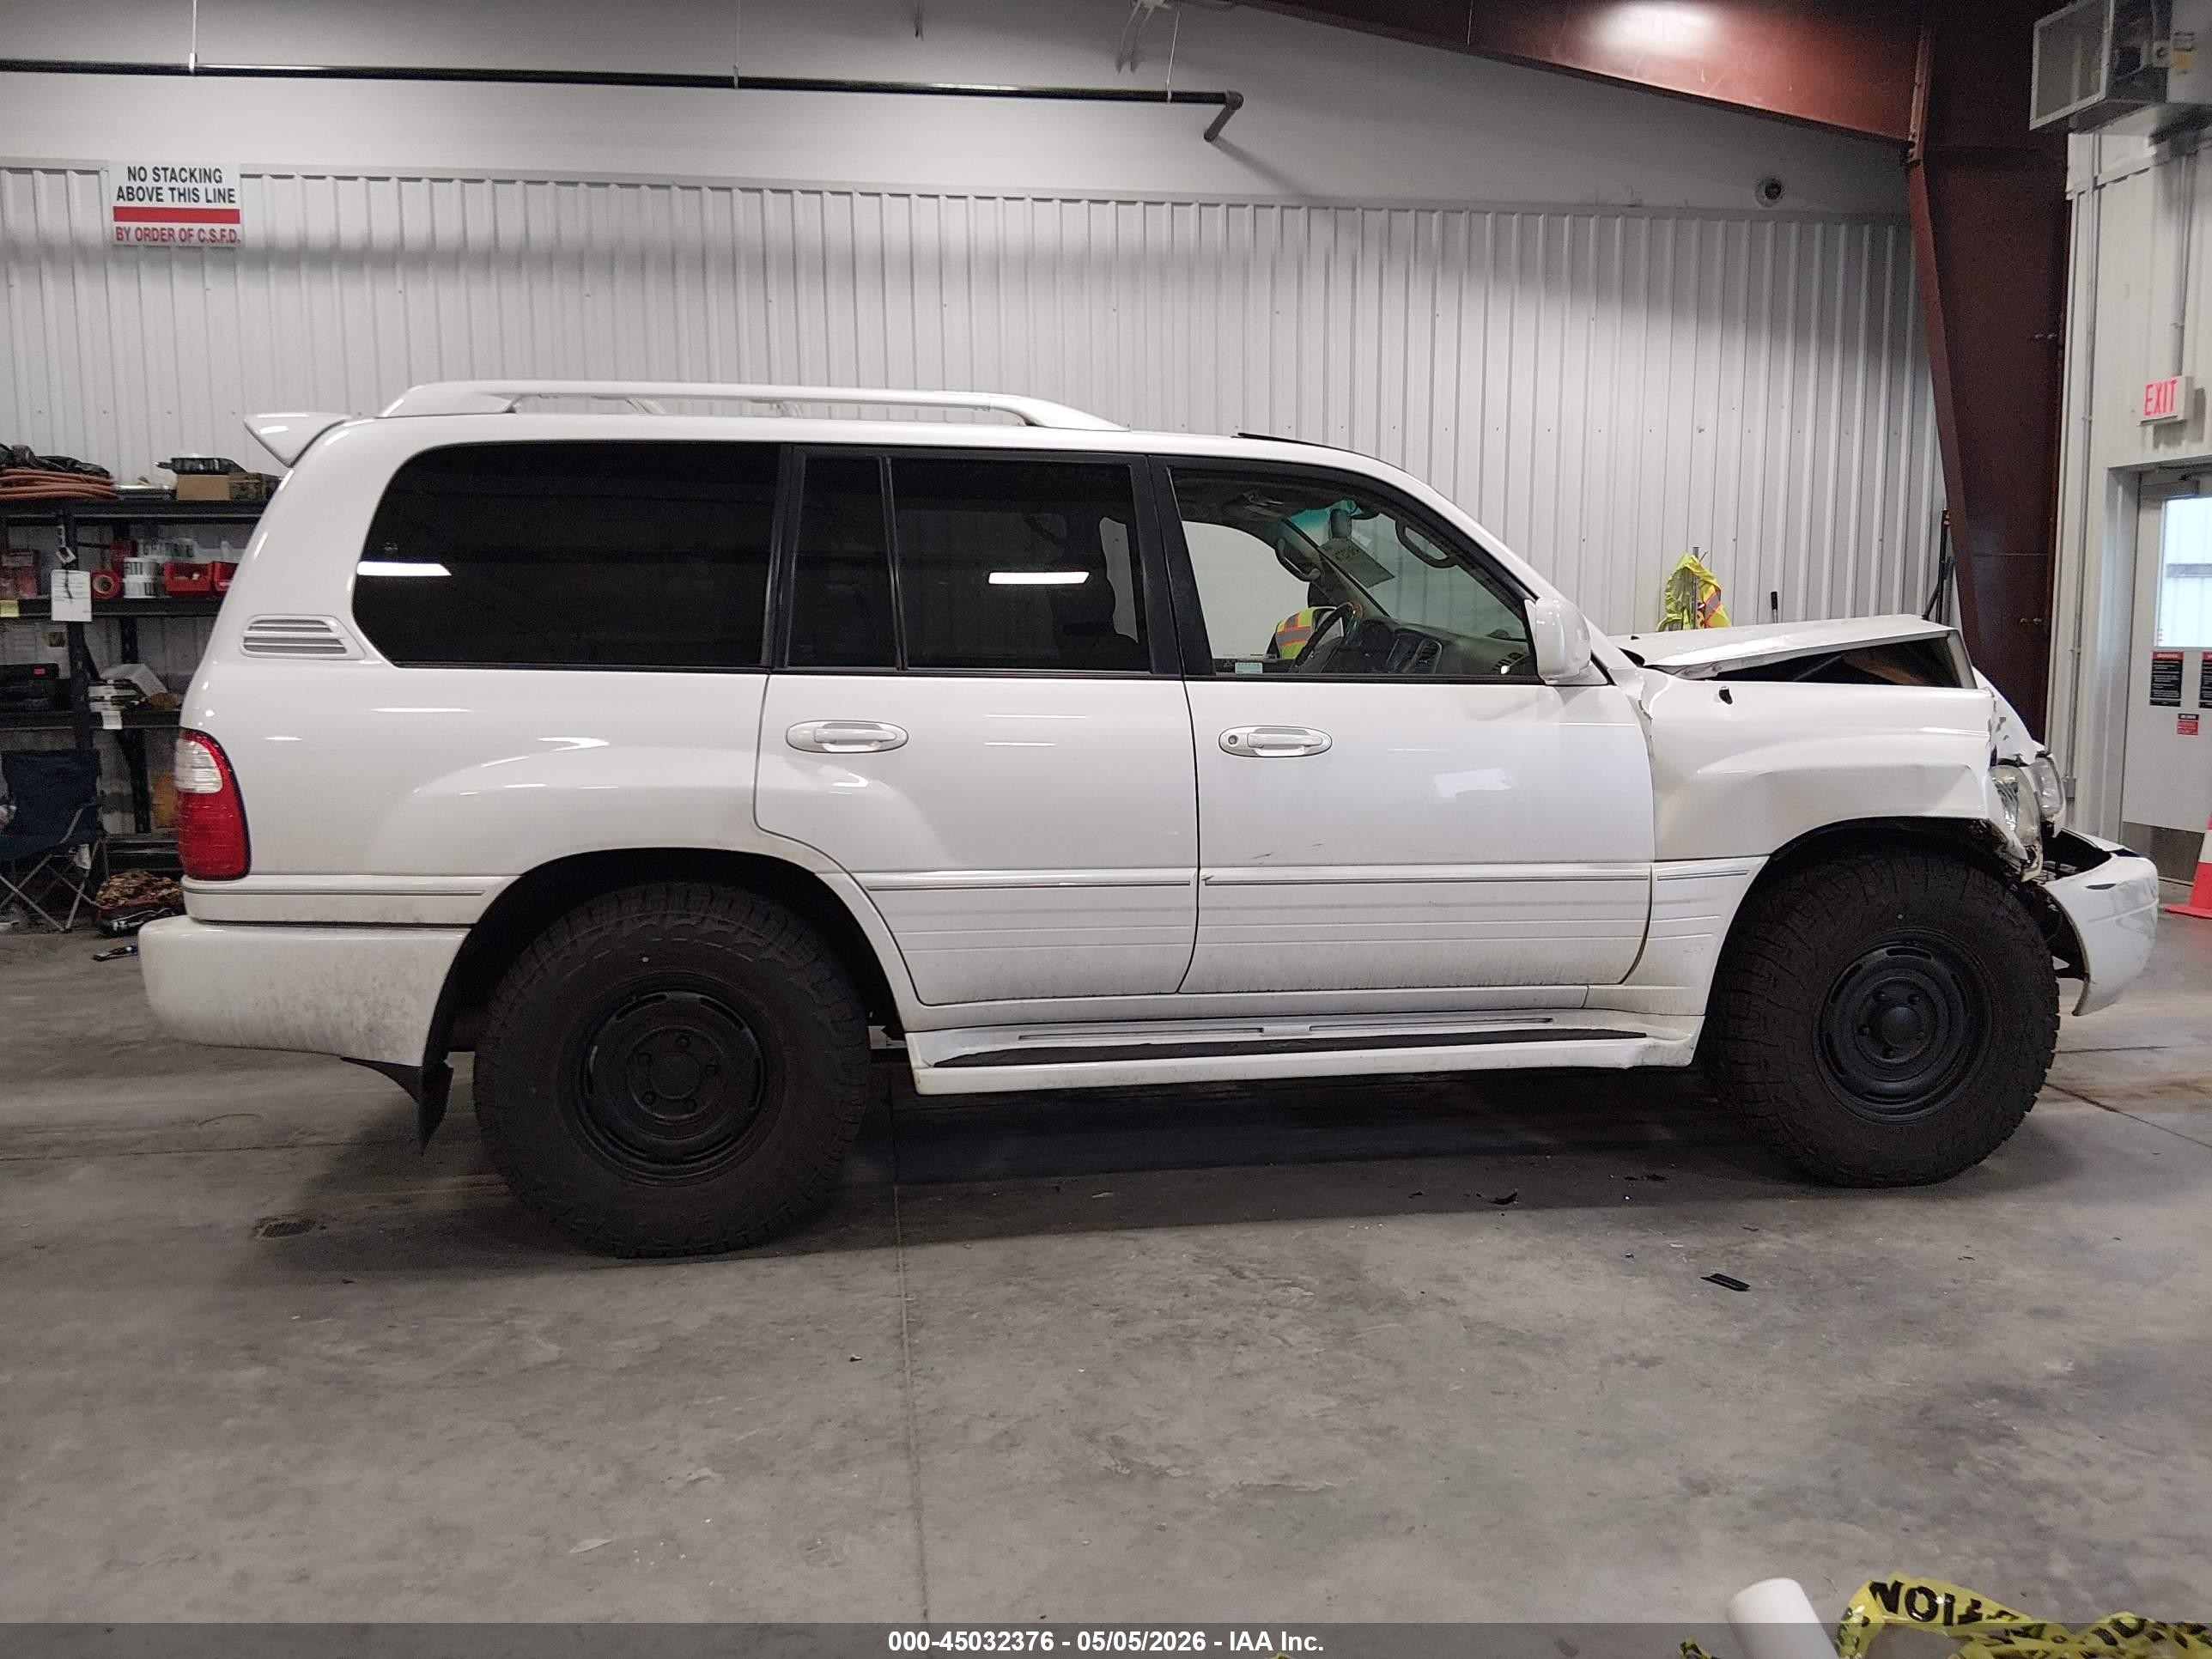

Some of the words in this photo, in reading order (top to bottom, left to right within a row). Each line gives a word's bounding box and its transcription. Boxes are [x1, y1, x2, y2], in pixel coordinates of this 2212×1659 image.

[127, 166, 148, 182] NO
[152, 167, 223, 184] STACKING
[116, 185, 164, 202] ABOVE
[168, 186, 200, 203] THIS
[205, 188, 236, 204] LINE
[115, 227, 131, 241] BY
[134, 227, 176, 242] ORDER
[179, 228, 194, 243] OF
[198, 228, 241, 243] C.S.F.D.
[2144, 380, 2178, 416] EXIT
